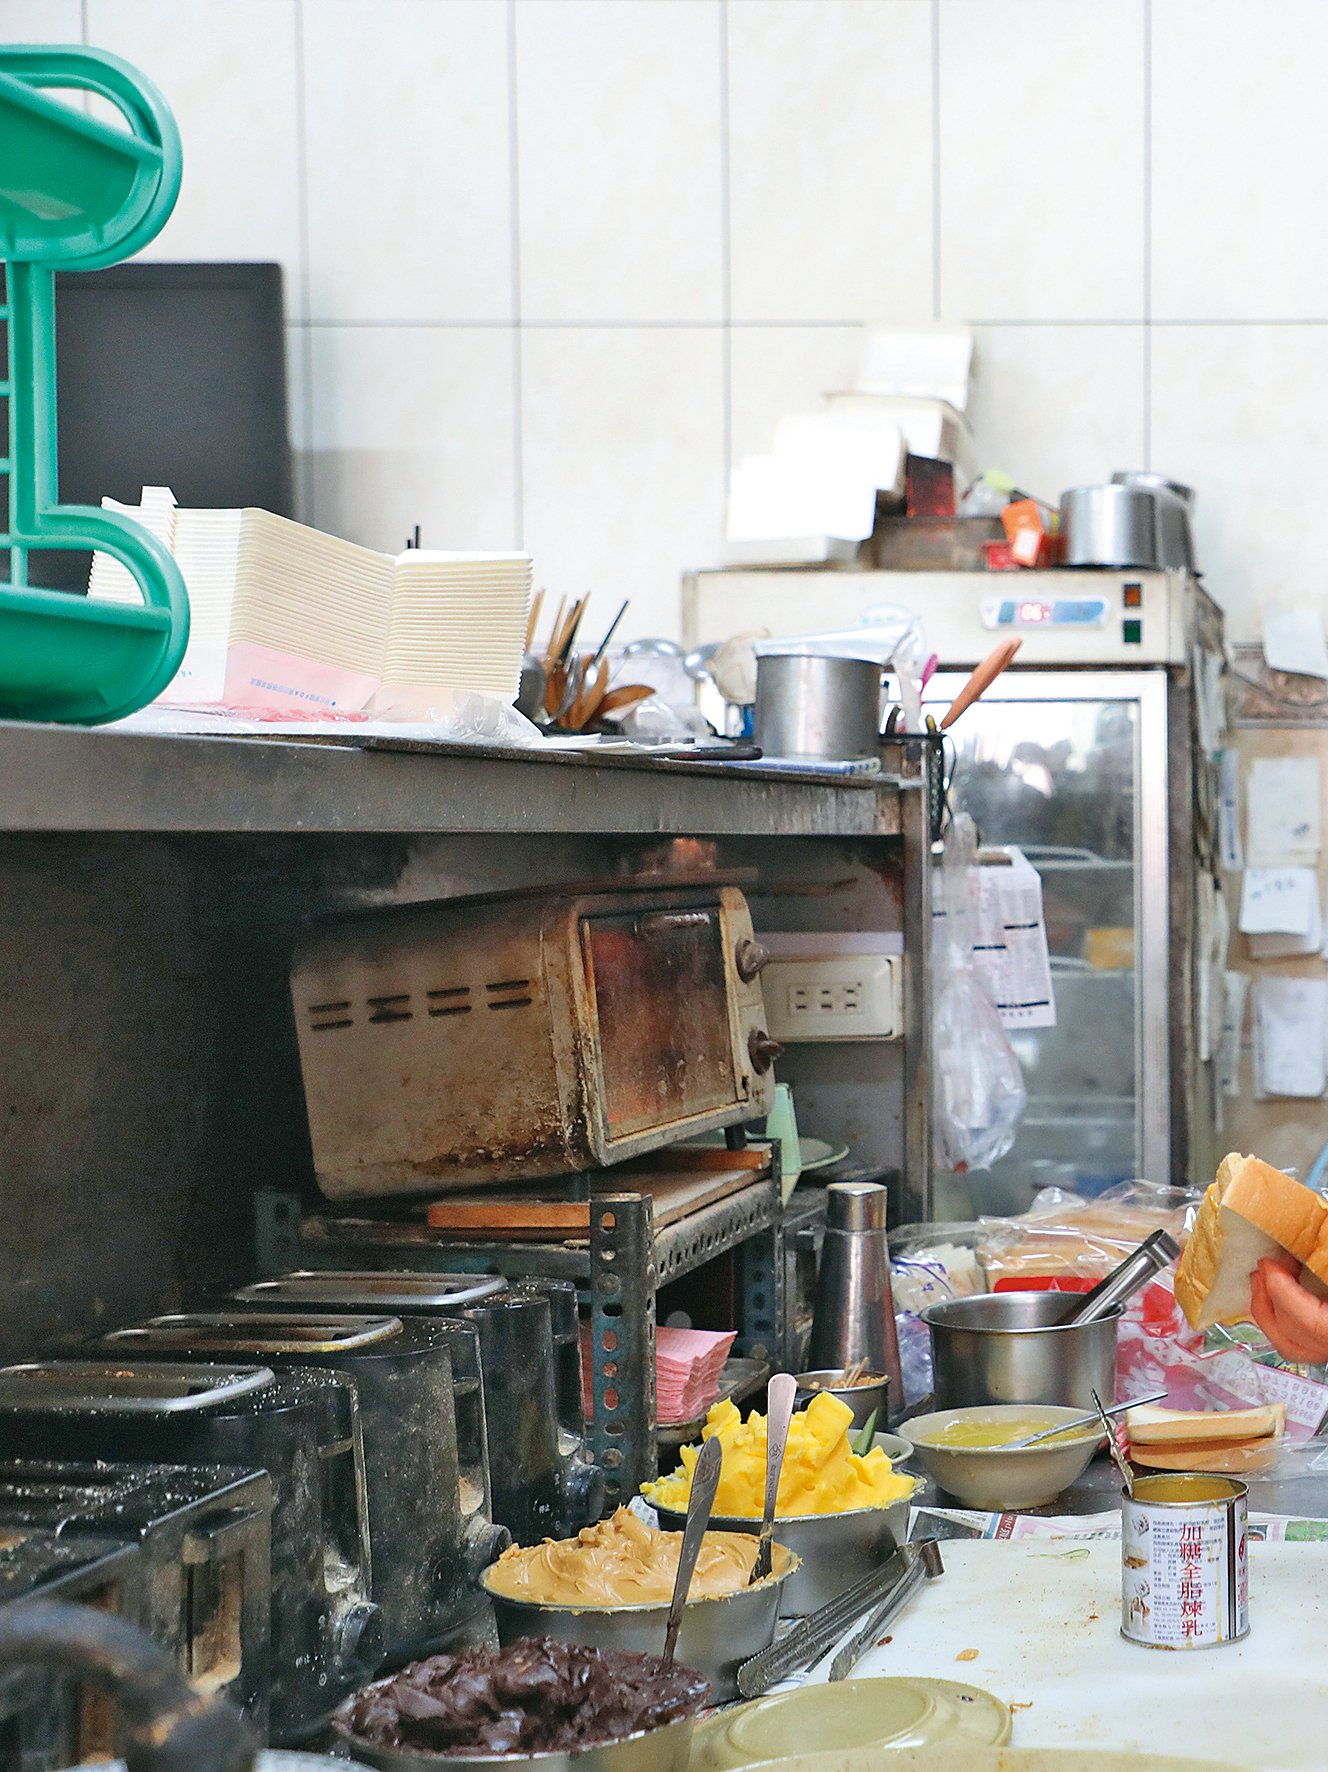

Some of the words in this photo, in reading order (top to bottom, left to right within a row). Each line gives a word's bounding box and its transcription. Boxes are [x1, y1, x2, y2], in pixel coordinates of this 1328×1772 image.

[1179, 1523, 1203, 1638] 加糖全脂煉乳
